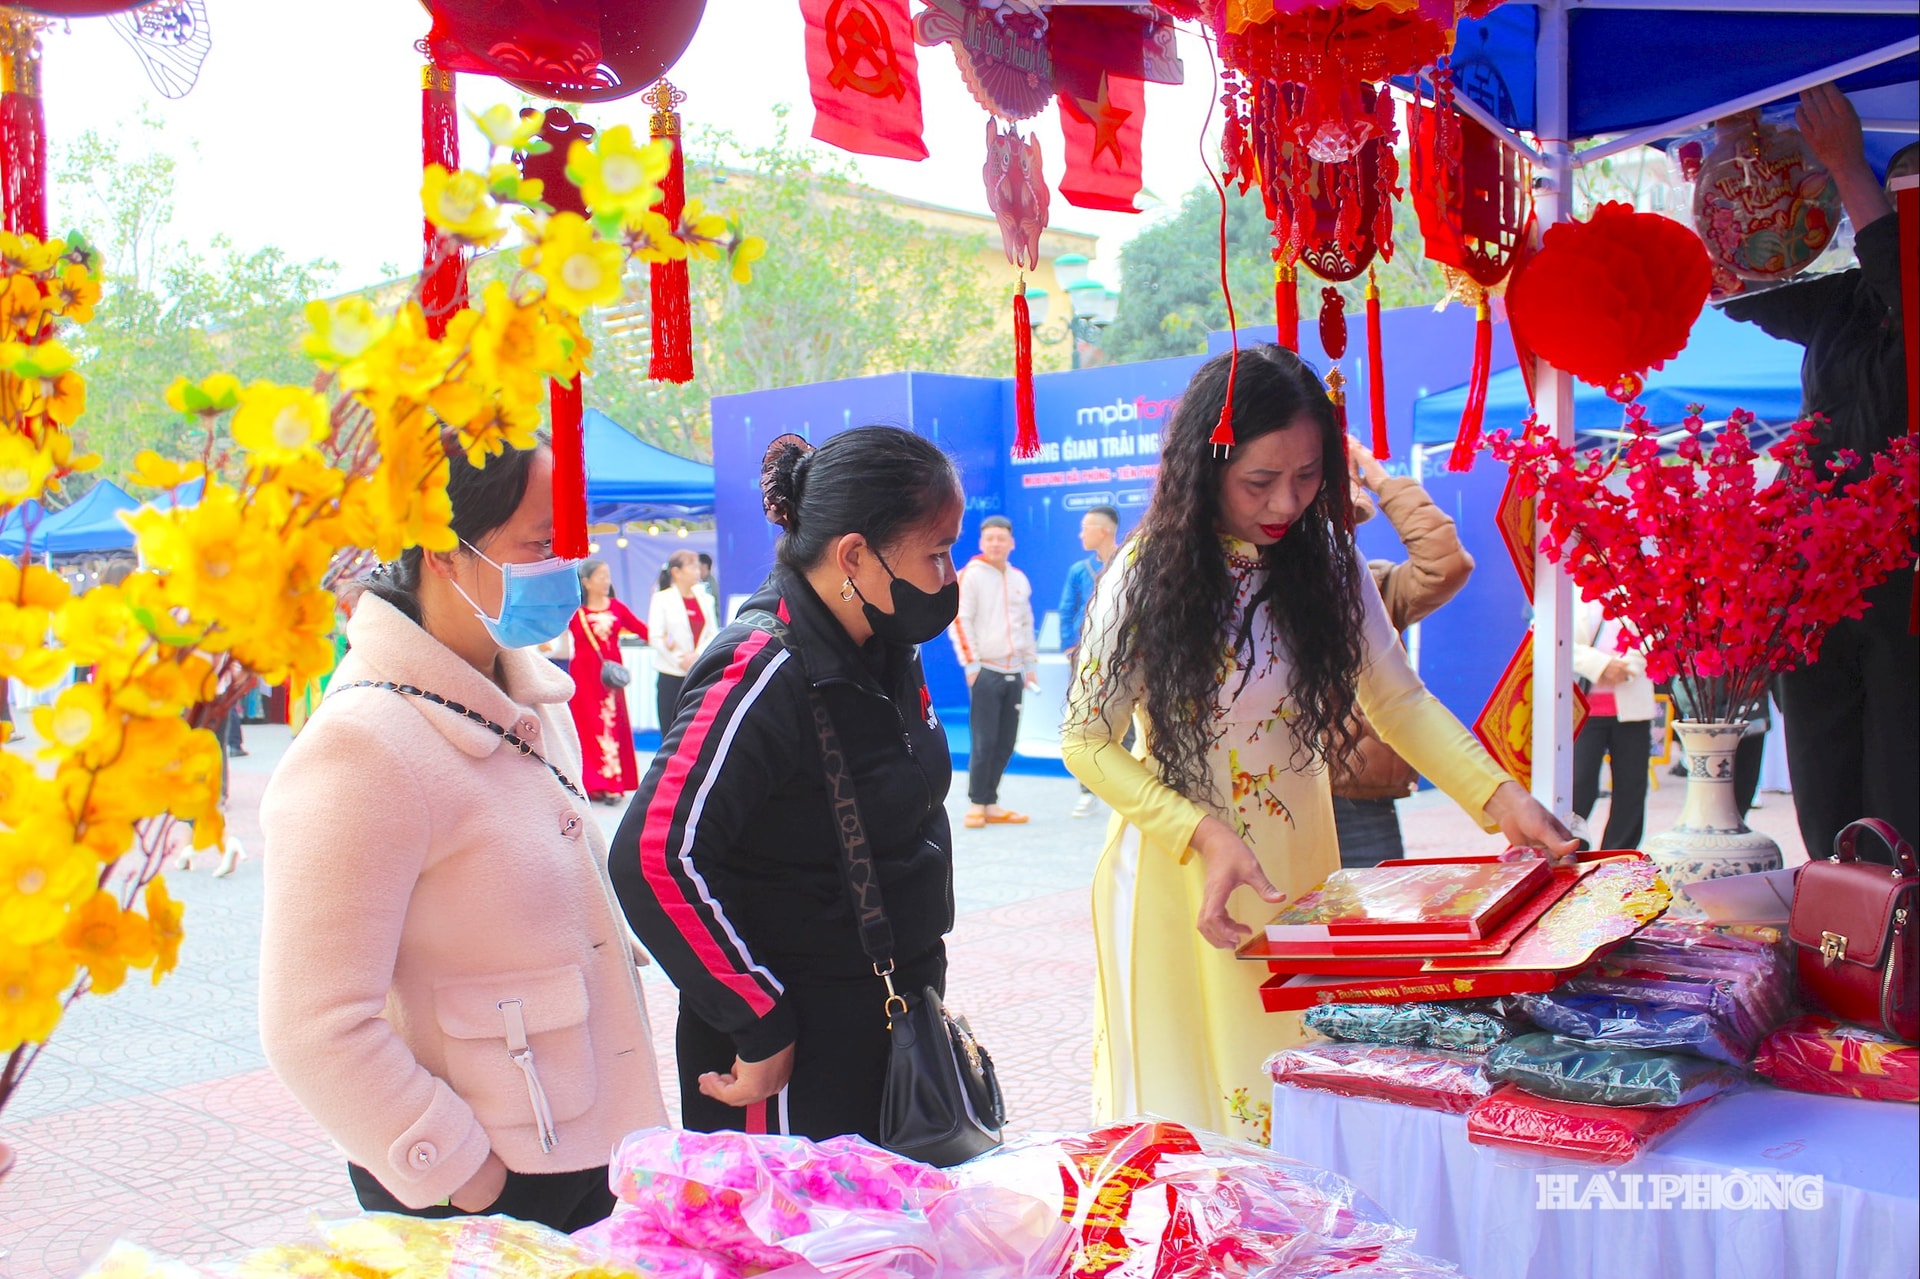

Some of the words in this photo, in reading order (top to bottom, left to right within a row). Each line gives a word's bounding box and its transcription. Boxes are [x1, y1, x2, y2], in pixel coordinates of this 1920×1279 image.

[1077, 395, 1178, 425] mobifon
[1062, 438, 1098, 463] GIAN
[1101, 429, 1134, 458] TRẢI
